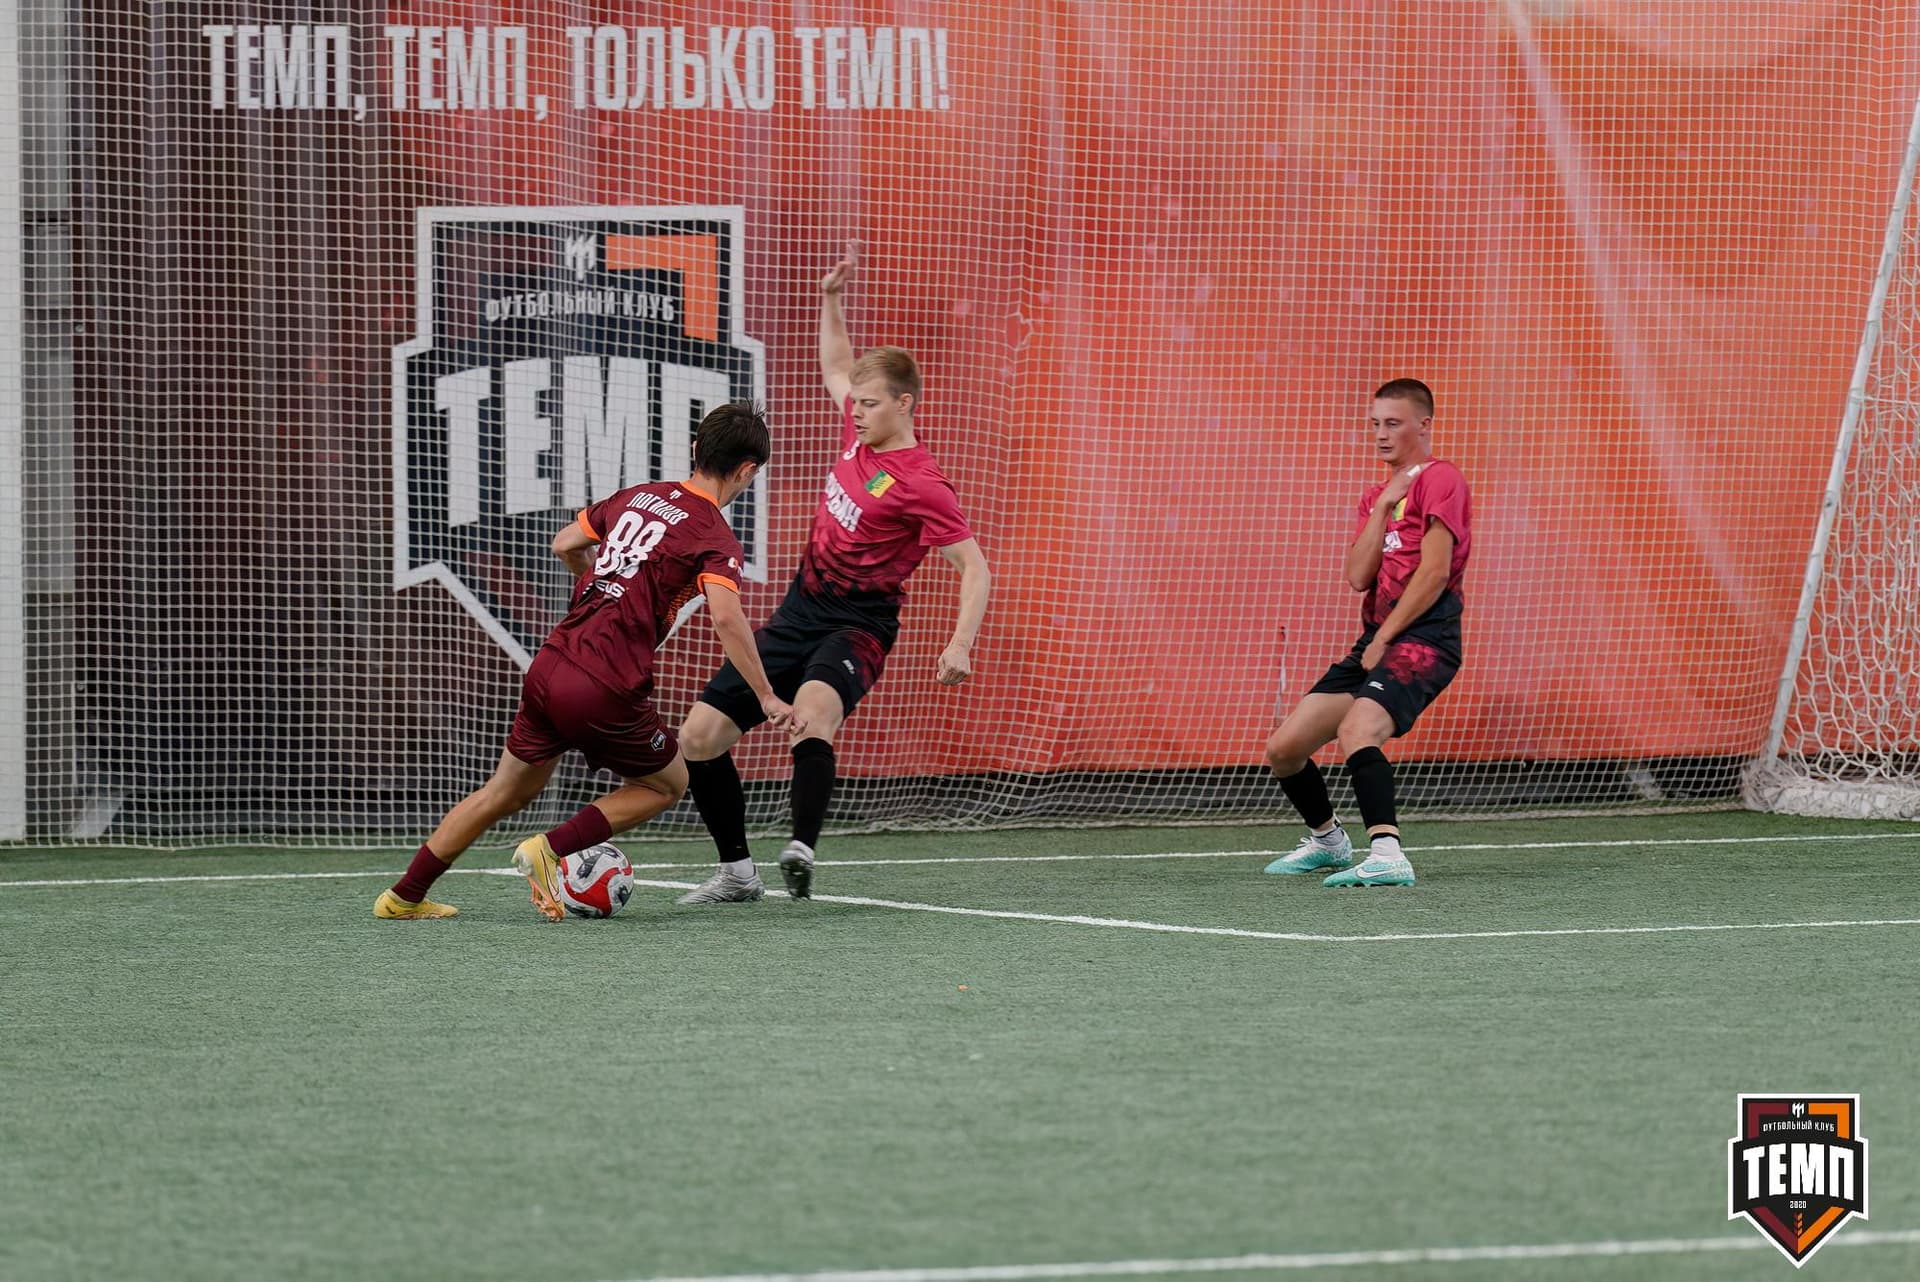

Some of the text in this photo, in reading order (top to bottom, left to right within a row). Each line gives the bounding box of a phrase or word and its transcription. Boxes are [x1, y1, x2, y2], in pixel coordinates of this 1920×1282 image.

[202, 24, 951, 123] ТЕМП, ТЕМП, ТОЛЬКО ТЕМП!
[486, 286, 675, 322] ФУТБОЛЬНЫЙ КЛУБ
[593, 510, 667, 580] 88
